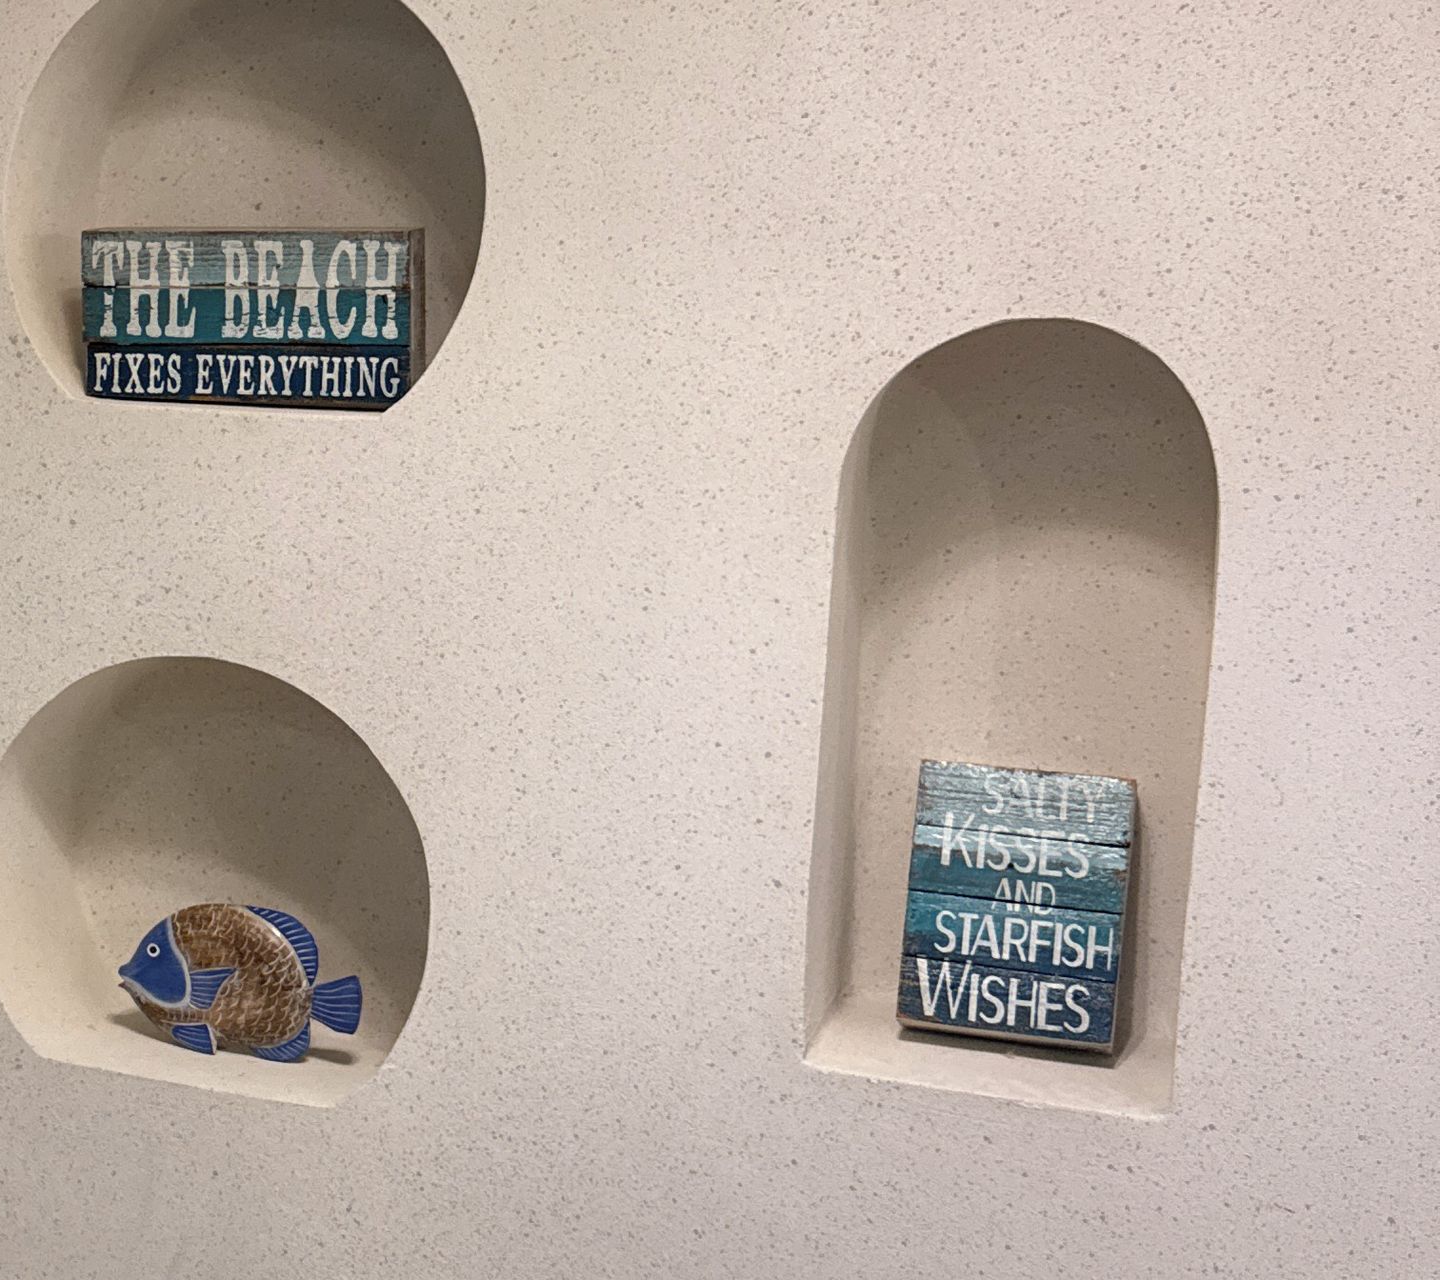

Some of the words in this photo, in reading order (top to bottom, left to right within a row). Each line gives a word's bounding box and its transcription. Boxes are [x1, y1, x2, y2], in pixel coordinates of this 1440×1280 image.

[92, 240, 197, 338] THE
[221, 239, 401, 340] BEACH
[93, 352, 183, 394] FIXES
[195, 354, 401, 399] EVERYTHING
[982, 773, 1106, 823] SALTY
[939, 812, 1090, 879] KISSES
[991, 878, 1056, 915] AND
[933, 910, 1114, 970] STARFISH
[916, 957, 1090, 1033] WISHES
